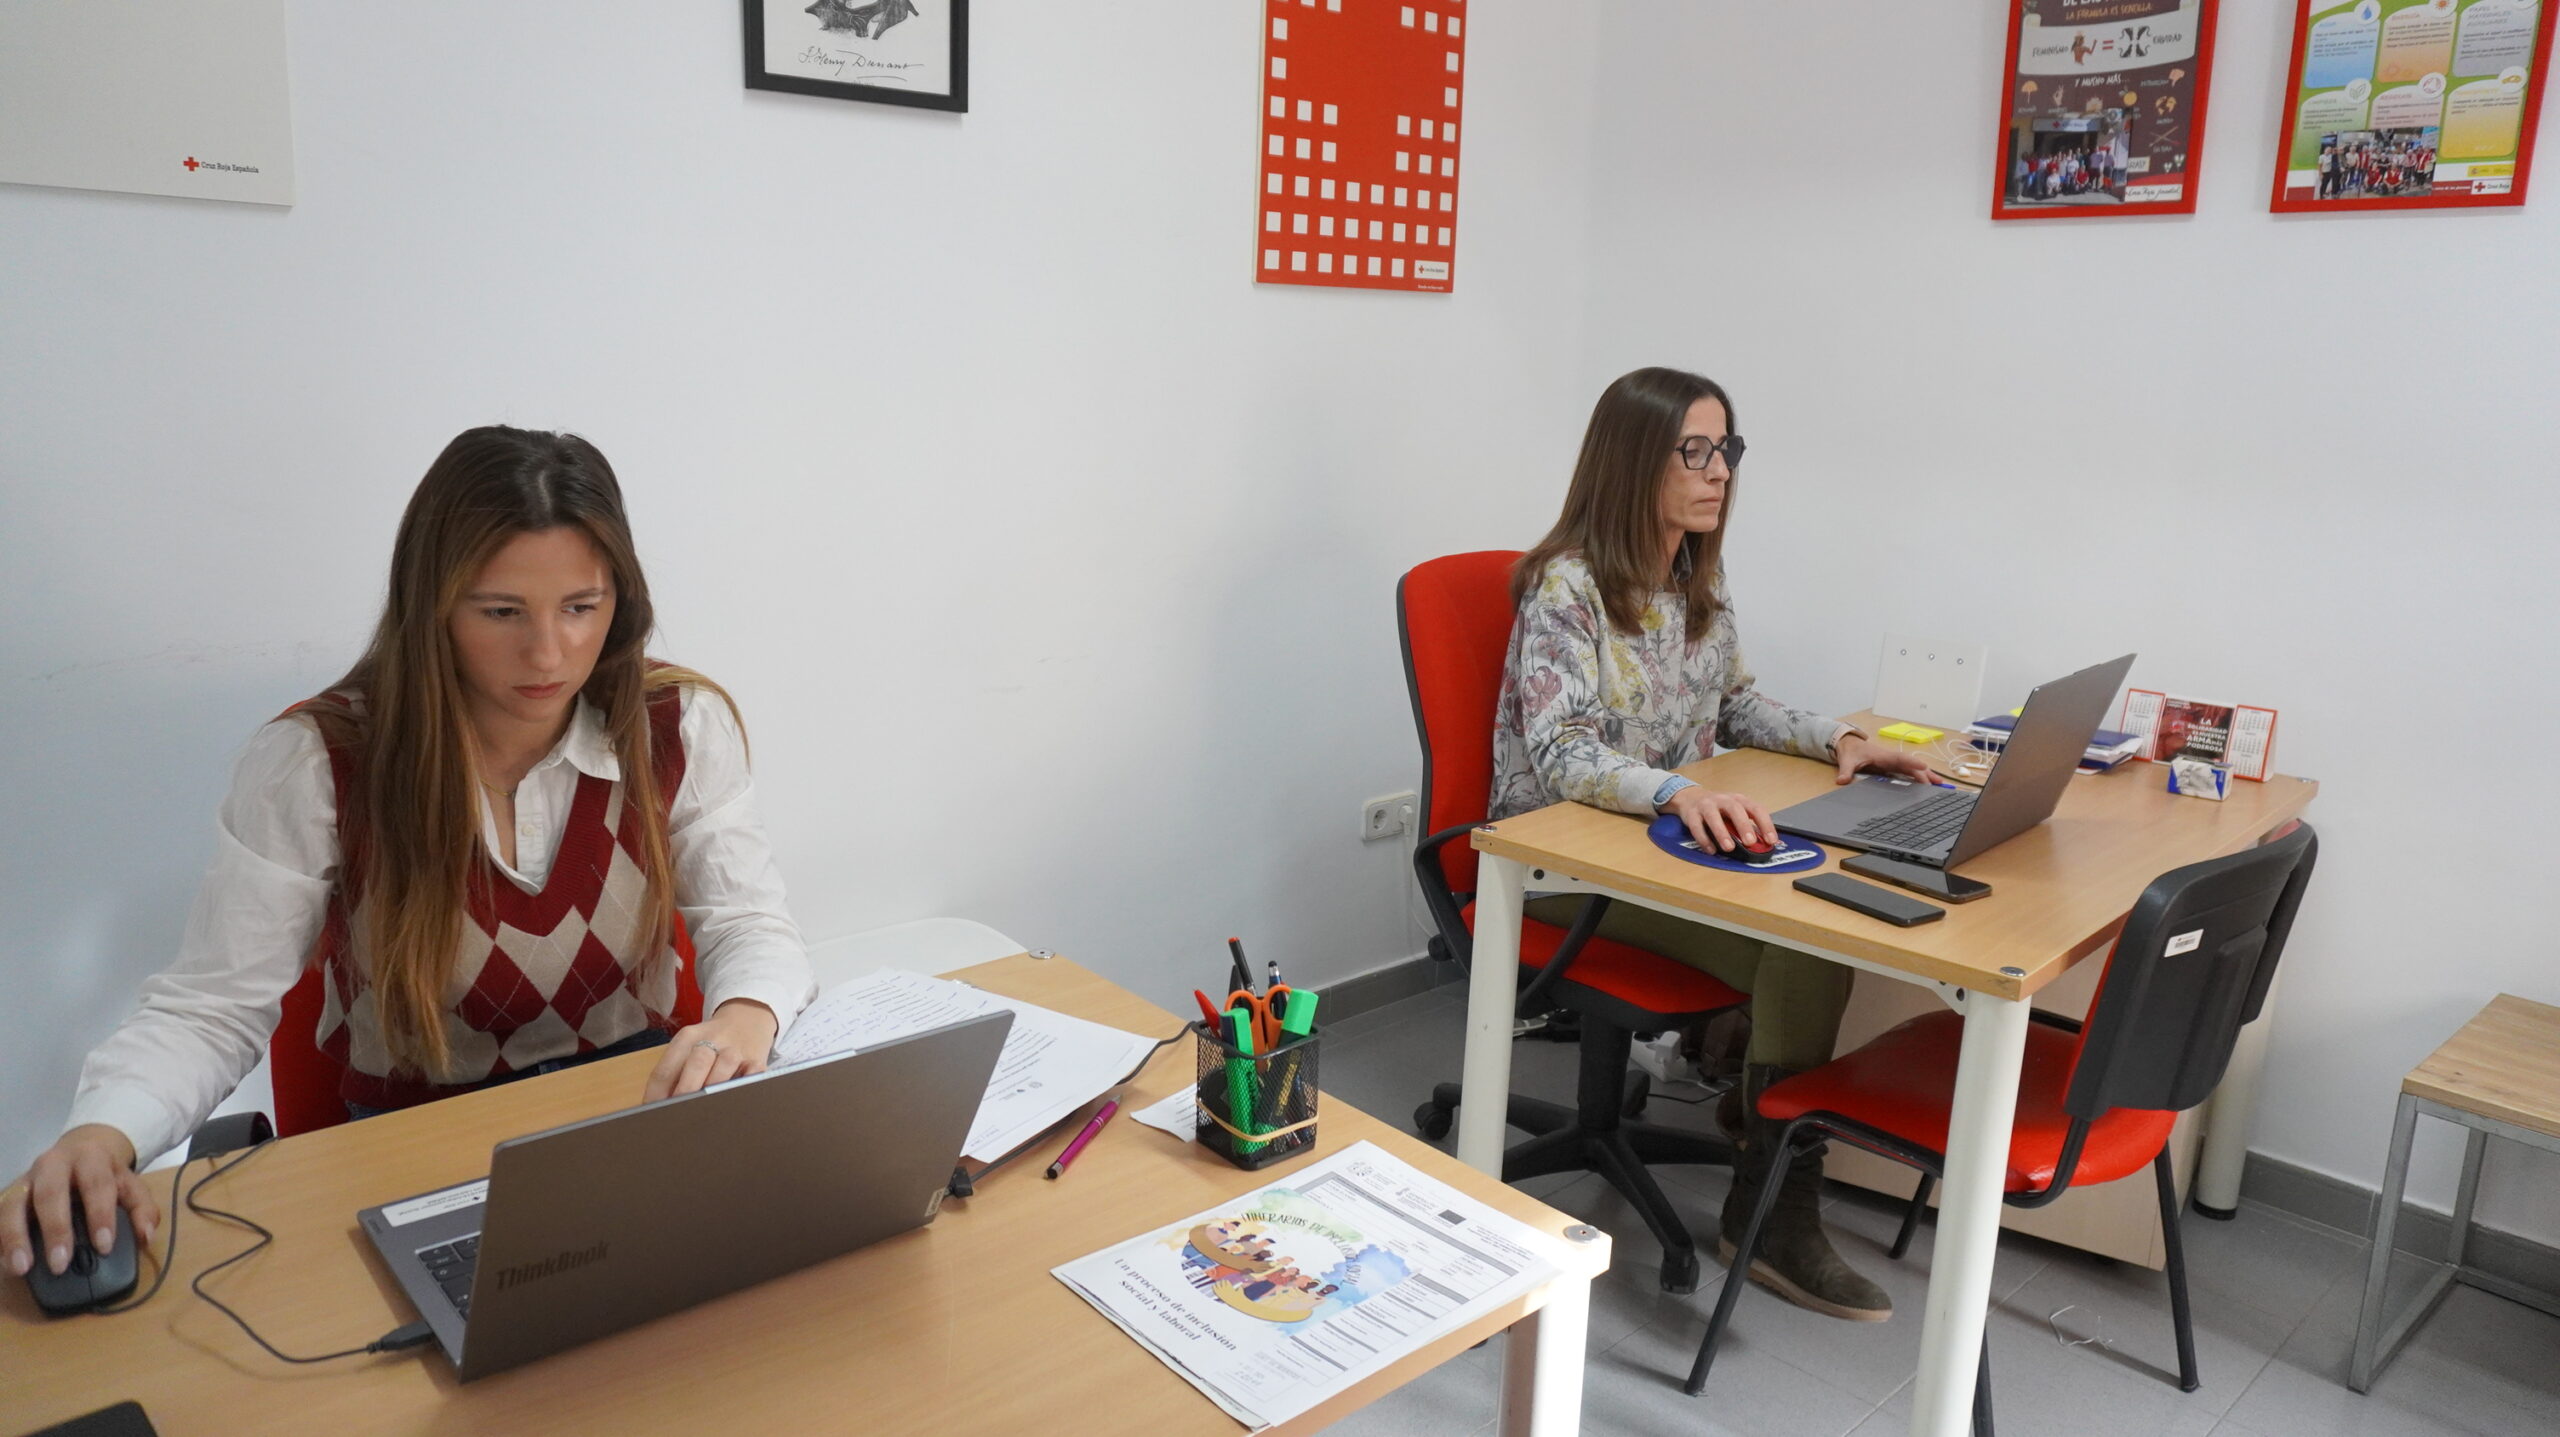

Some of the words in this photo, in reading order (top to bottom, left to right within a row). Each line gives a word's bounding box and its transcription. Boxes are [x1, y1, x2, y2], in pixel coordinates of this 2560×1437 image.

[201, 161, 216, 170] Cruz
[216, 162, 231, 172] Roja
[232, 164, 260, 174] Española
[2200, 717, 2212, 726] LA
[2187, 733, 2212, 745] ARMA
[496, 1240, 610, 1293] ThinkBook
[1119, 1279, 1155, 1306] social
[1158, 1309, 1202, 1341] laboral
[1127, 1269, 1172, 1304] proceso
[1169, 1301, 1187, 1314] de
[1184, 1310, 1237, 1352] inclusión
